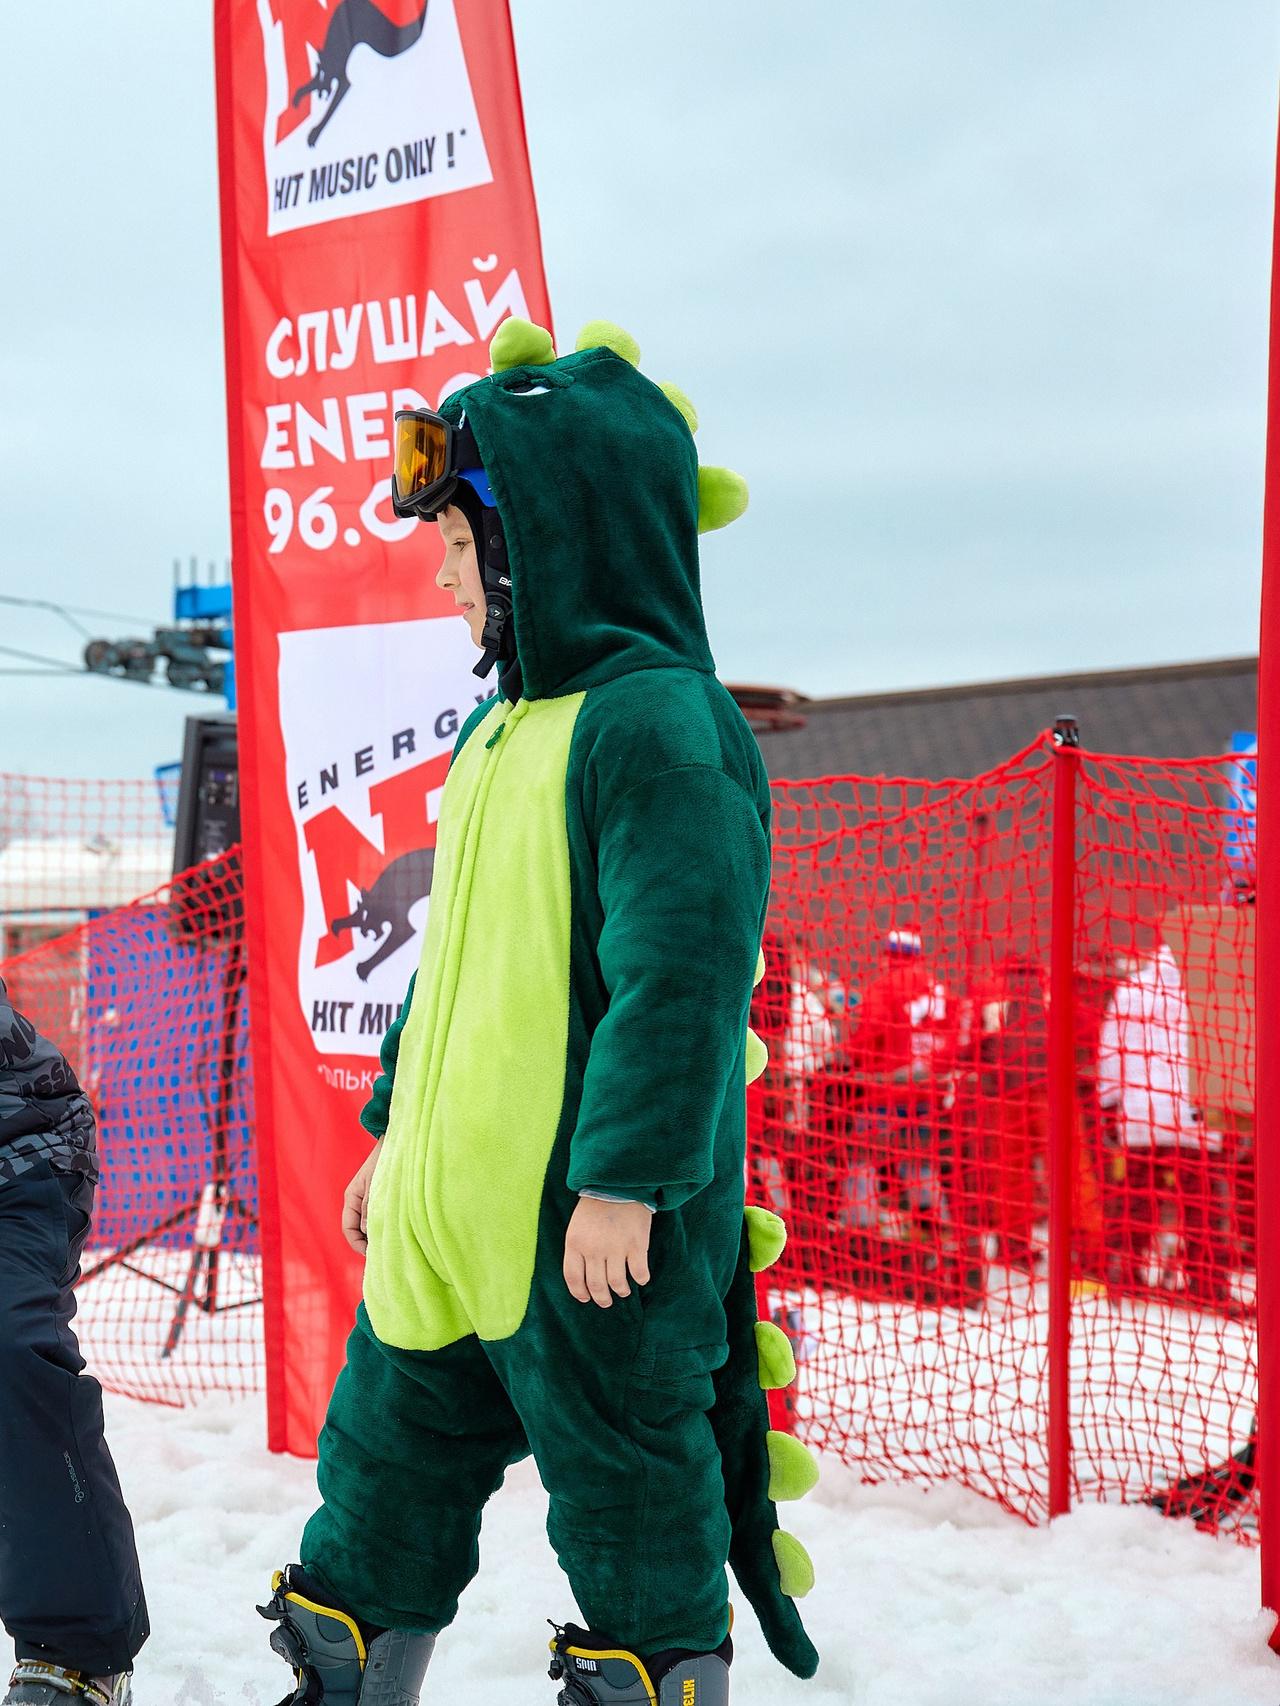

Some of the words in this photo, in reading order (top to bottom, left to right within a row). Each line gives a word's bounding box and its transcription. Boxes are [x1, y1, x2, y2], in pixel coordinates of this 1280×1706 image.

[273, 172, 304, 212] HIT
[308, 153, 379, 204] MUSIC
[385, 135, 436, 184] ONLY
[265, 253, 532, 379] СЛУШАЙ
[311, 999, 354, 1033] HIT
